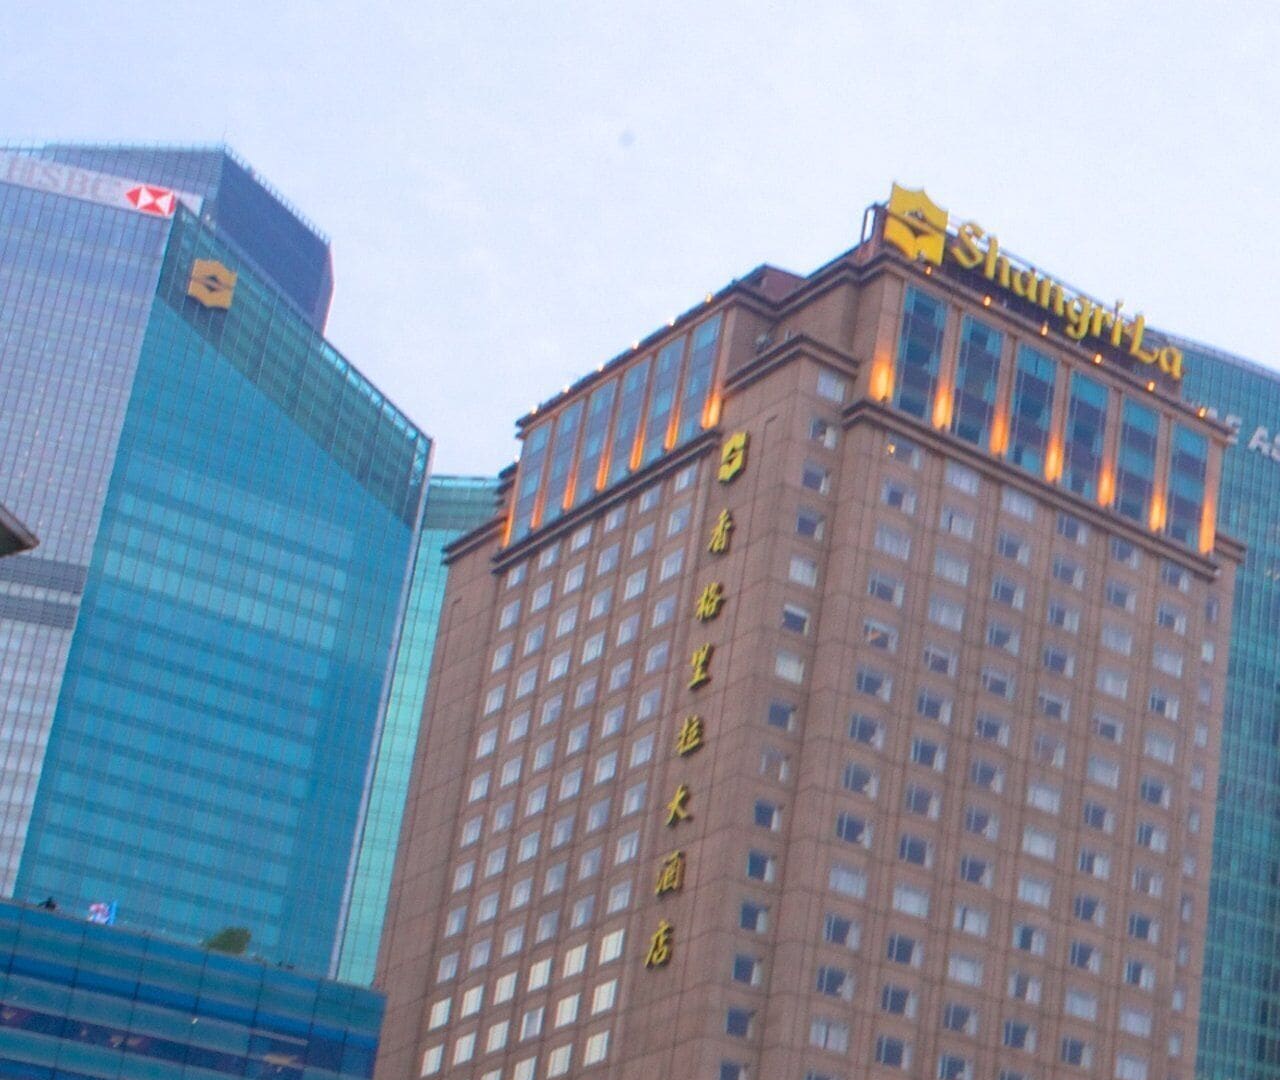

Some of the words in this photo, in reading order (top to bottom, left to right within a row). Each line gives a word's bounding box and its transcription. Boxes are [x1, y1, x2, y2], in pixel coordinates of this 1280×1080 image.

[645, 508, 733, 968] 香格里拉大酒店
